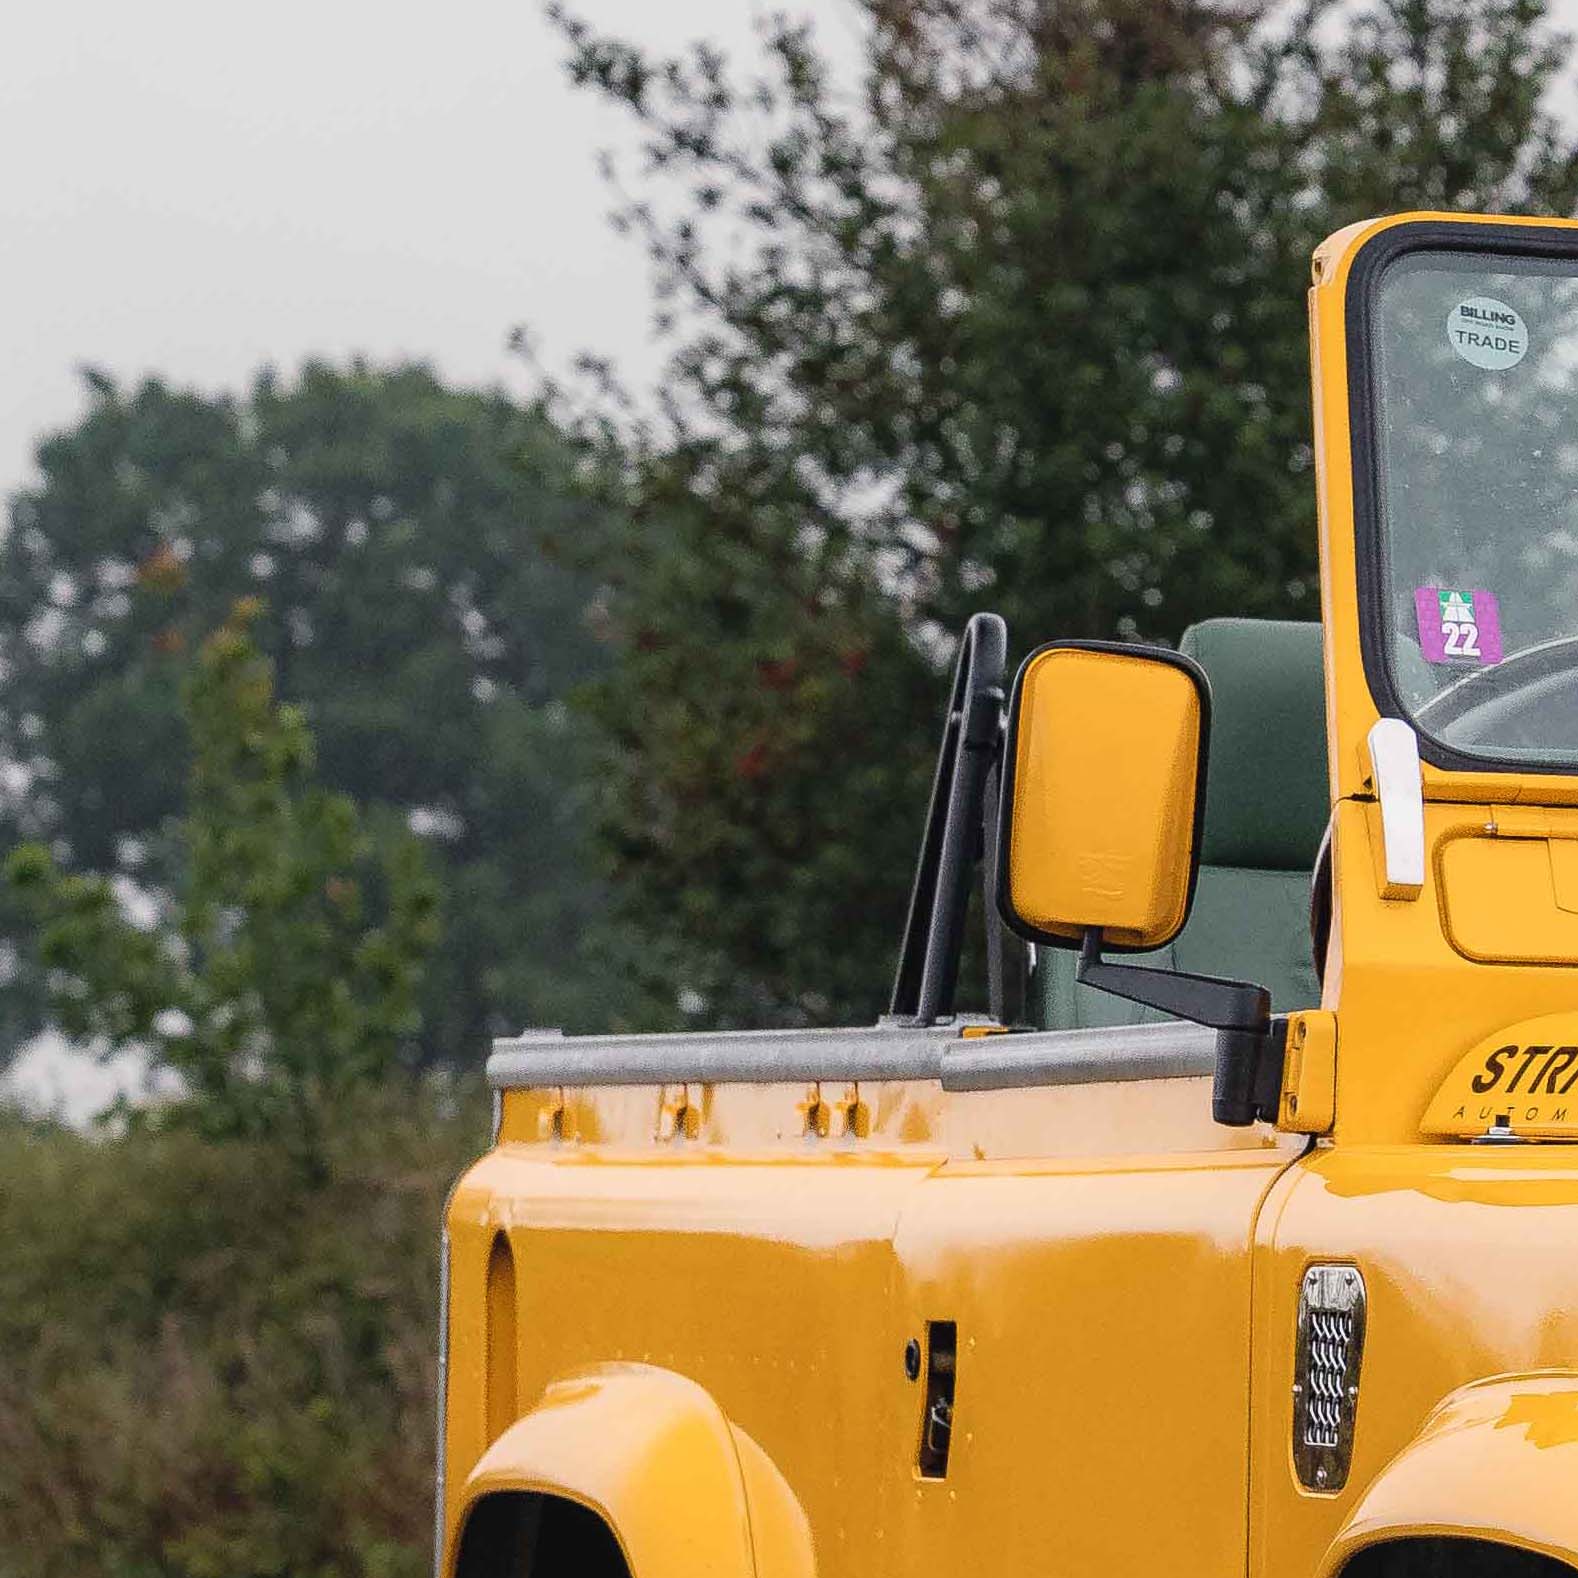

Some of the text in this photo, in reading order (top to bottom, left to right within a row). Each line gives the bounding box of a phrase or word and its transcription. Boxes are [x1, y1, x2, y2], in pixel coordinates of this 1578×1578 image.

[1460, 305, 1516, 325] BILLING
[1456, 330, 1520, 354] TRADE
[1441, 622, 1481, 657] 22
